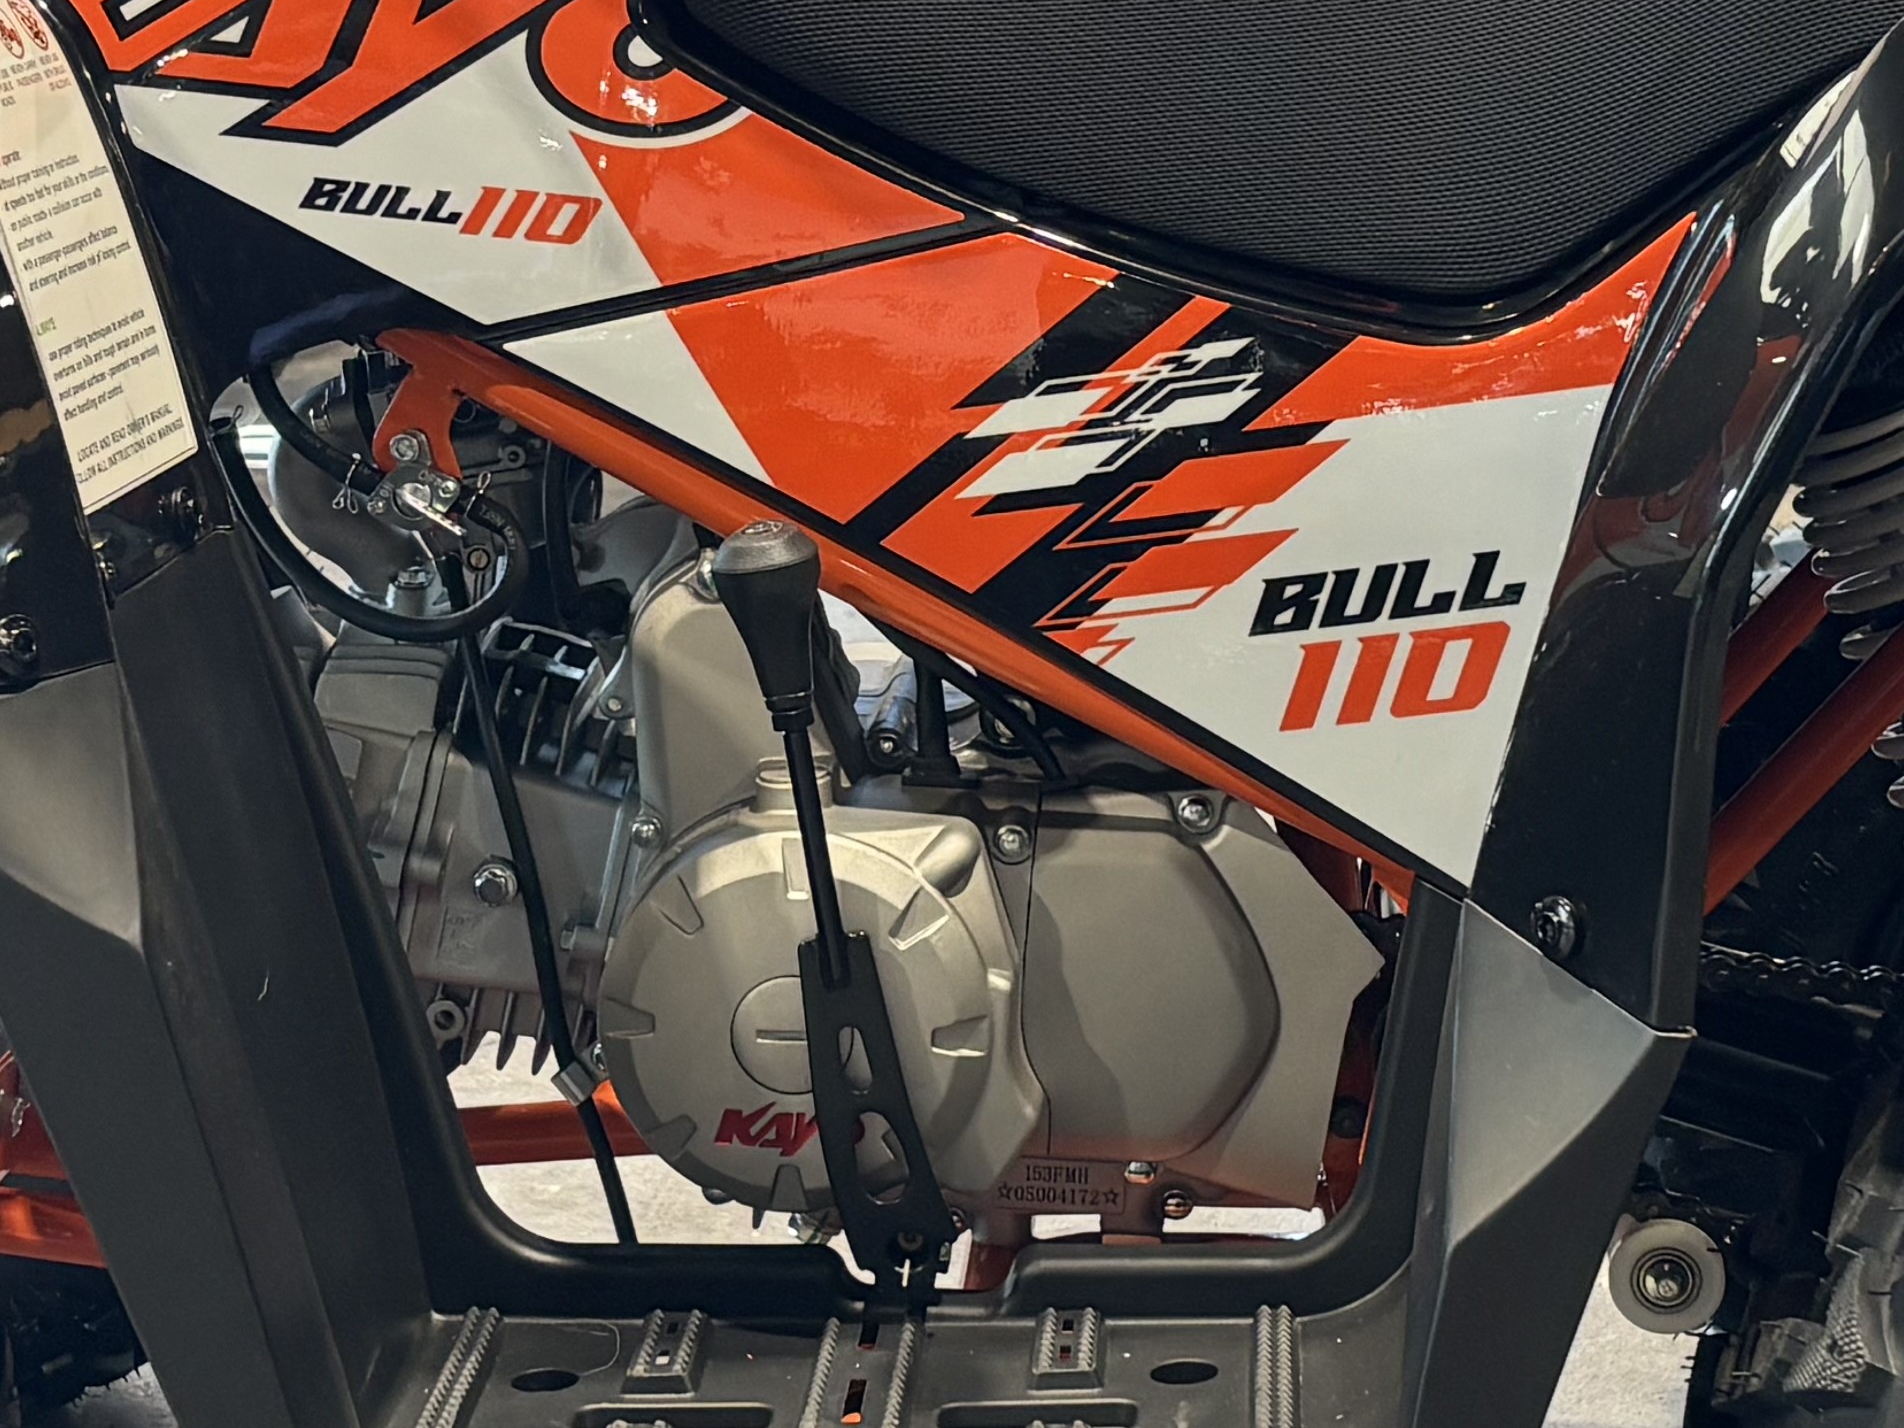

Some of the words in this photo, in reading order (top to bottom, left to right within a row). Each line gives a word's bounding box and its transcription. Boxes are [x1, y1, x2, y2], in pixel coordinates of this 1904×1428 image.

[1249, 550, 1527, 636] BULL
[1279, 620, 1511, 733] 110
[714, 1101, 867, 1157] KAY
